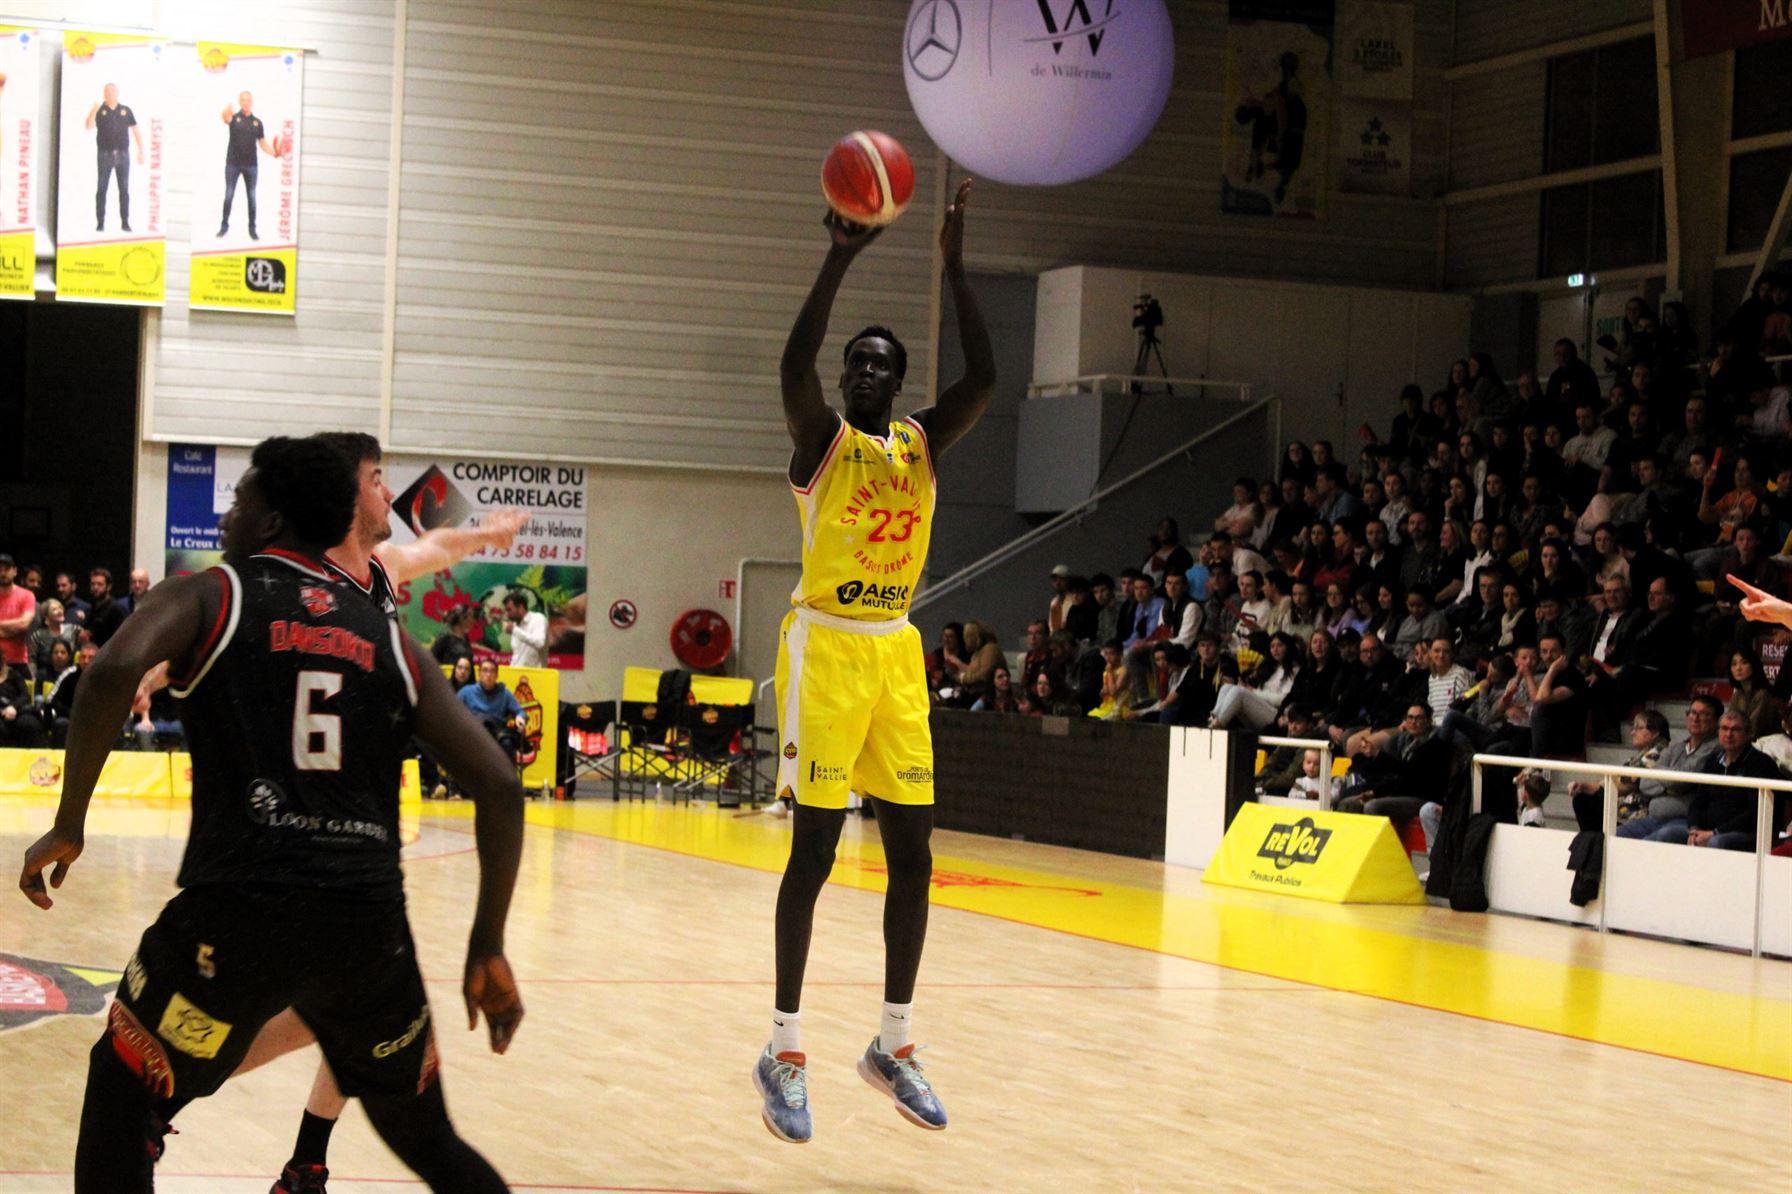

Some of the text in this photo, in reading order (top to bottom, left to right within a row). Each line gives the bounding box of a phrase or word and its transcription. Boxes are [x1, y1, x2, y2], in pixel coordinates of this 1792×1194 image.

[1031, 63, 1046, 77] de
[17, 119, 31, 224] NATHAN PINEAU
[147, 118, 163, 232] PHILIPPE NAMYST
[453, 462, 585, 486] COMPTOIR DU
[477, 486, 583, 509] CARRELAGE
[170, 525, 194, 536] Ouvert
[868, 508, 914, 543] 23
[170, 536, 182, 548] Le
[184, 536, 214, 549] Creux
[515, 544, 535, 558] 58
[539, 544, 558, 560] 84
[565, 545, 582, 561] 15
[293, 670, 343, 771] 6
[816, 766, 844, 774] SAINT
[816, 773, 848, 781] VALLIE
[1250, 869, 1302, 887] Travaux Publics
